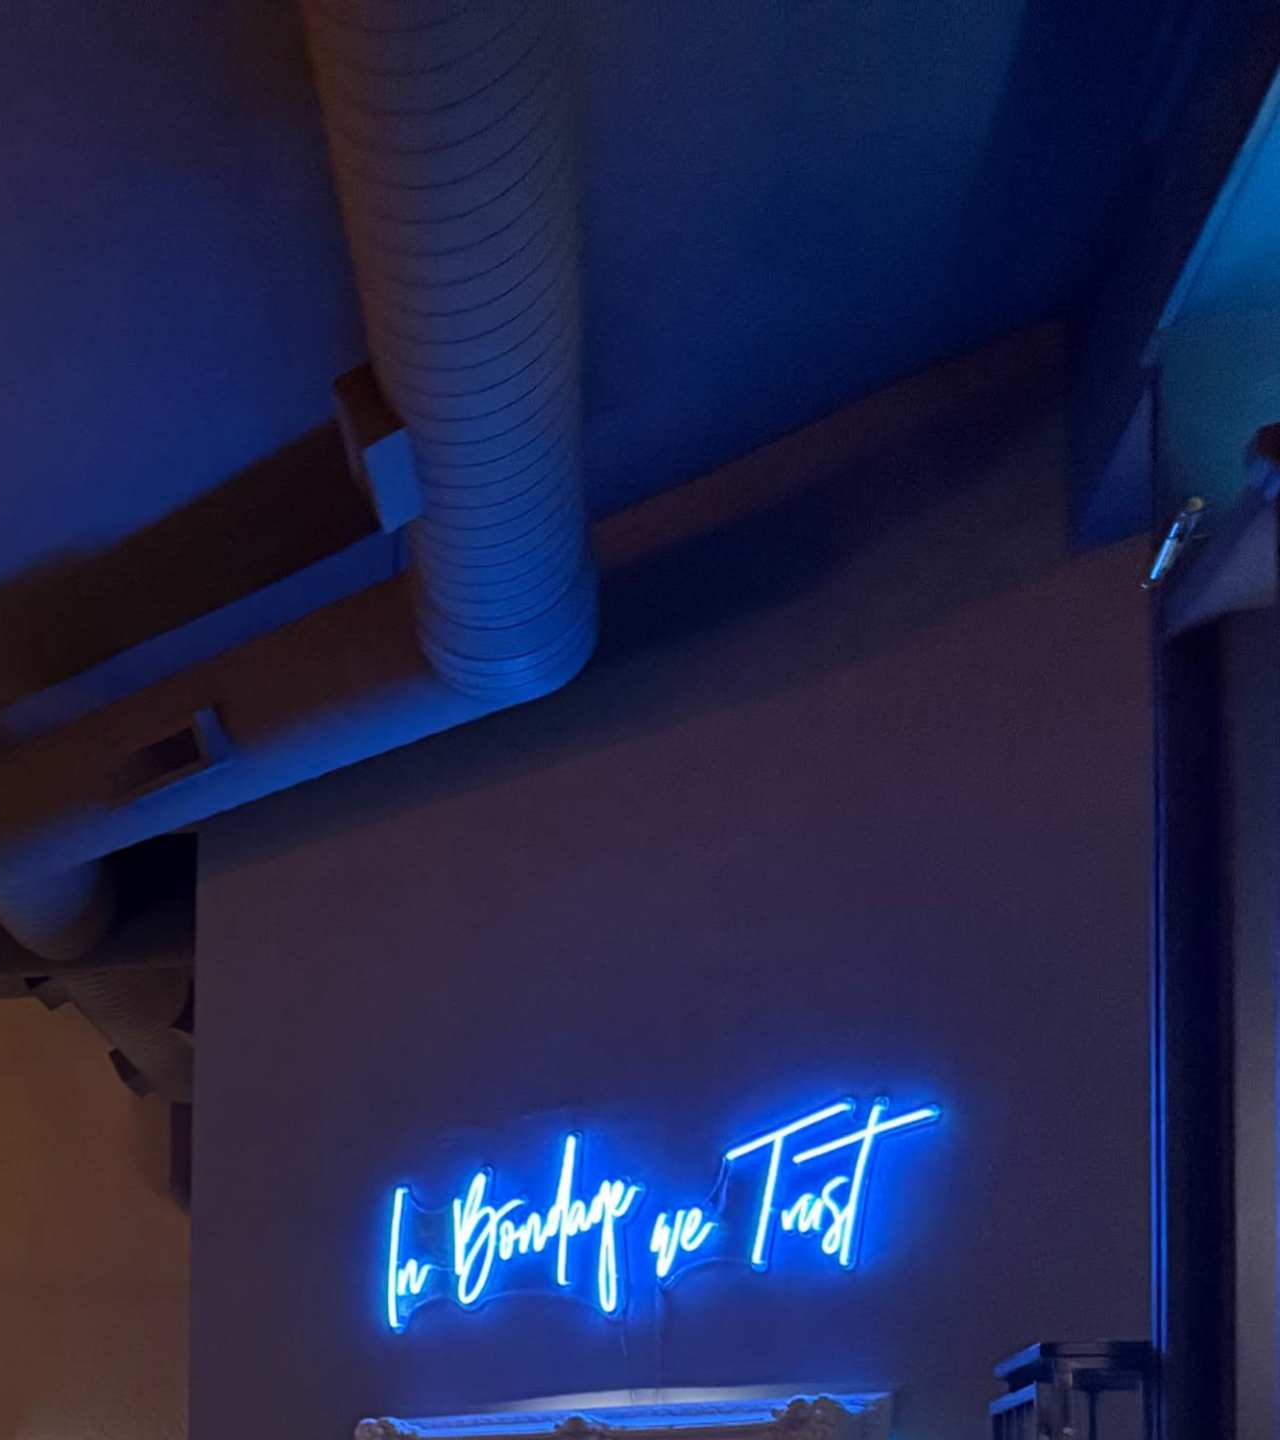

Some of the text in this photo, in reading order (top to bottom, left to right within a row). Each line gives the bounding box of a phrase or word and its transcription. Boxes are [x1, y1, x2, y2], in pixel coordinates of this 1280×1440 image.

[387, 1097, 939, 1330] In Bondage we Trust
